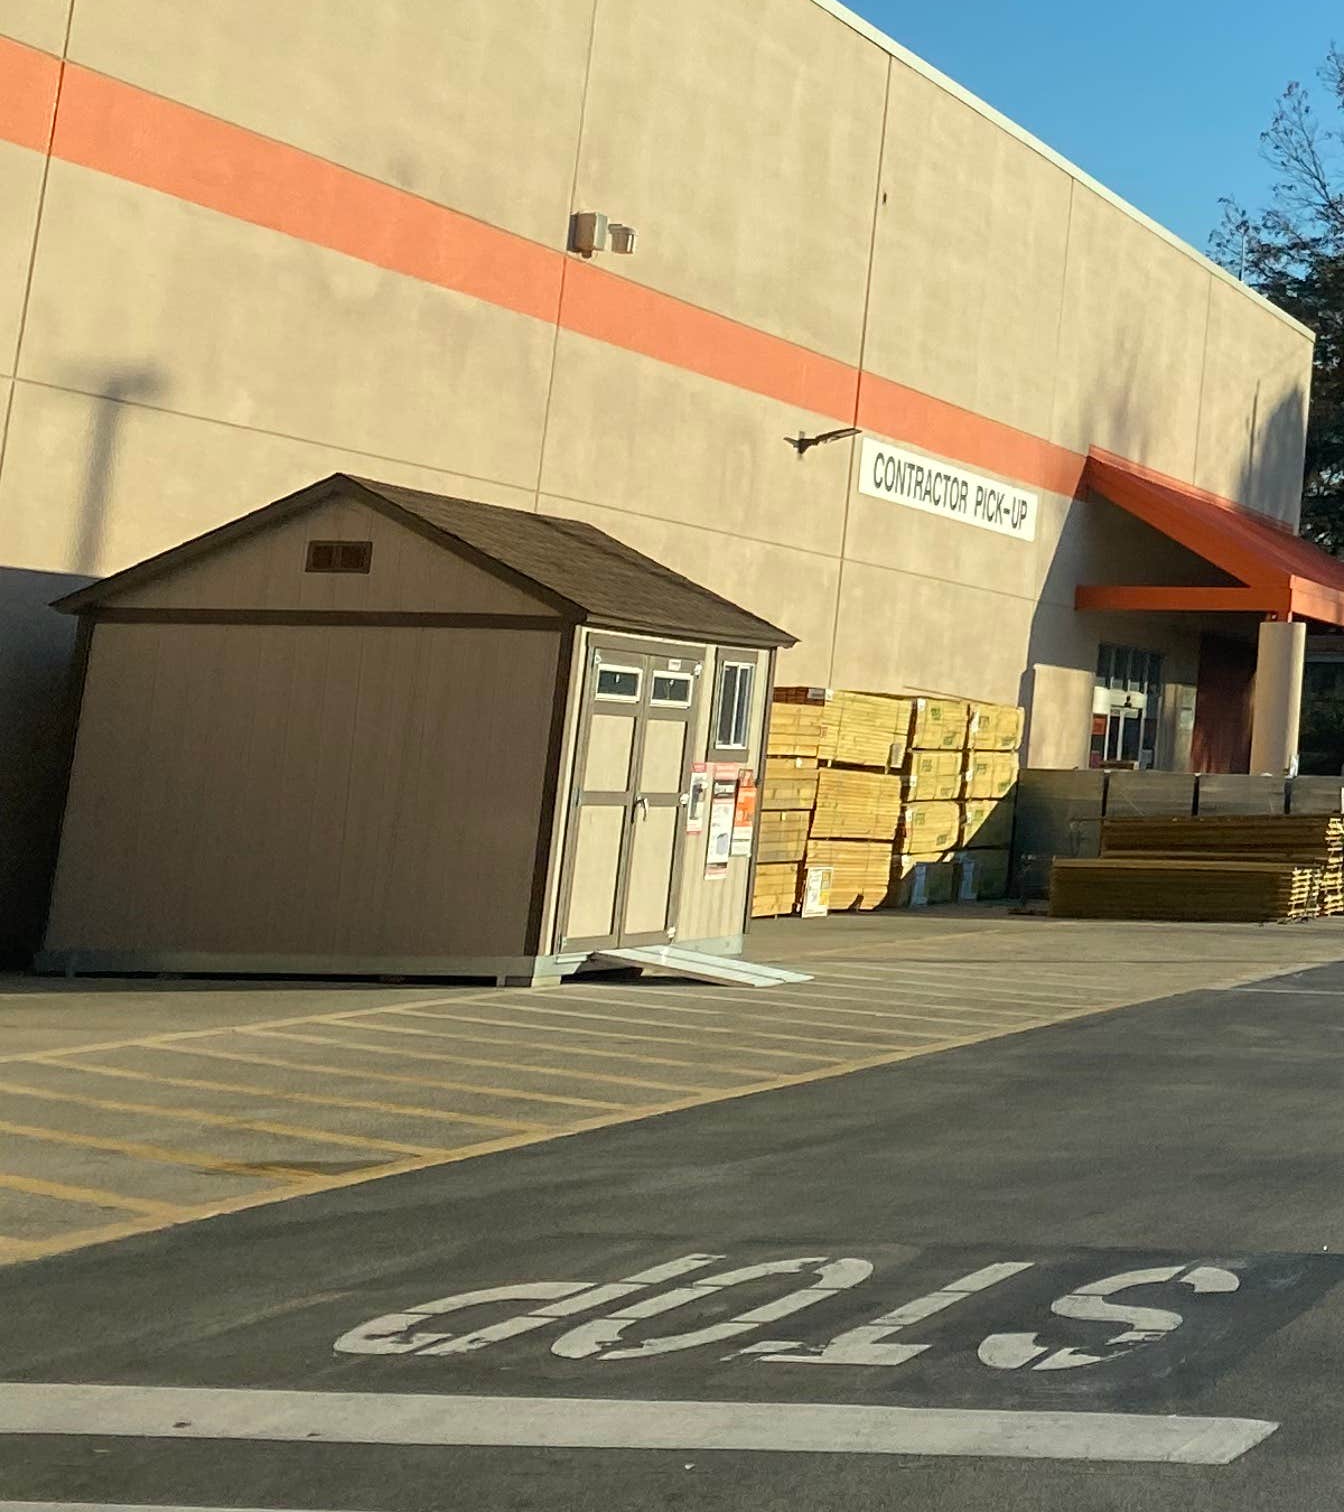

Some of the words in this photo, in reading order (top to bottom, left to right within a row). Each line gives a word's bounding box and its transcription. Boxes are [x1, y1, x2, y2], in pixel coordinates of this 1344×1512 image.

[873, 452, 968, 514] CONTRACTOR
[974, 485, 1028, 530] PICK-UP
[333, 1253, 1241, 1371] STOP
